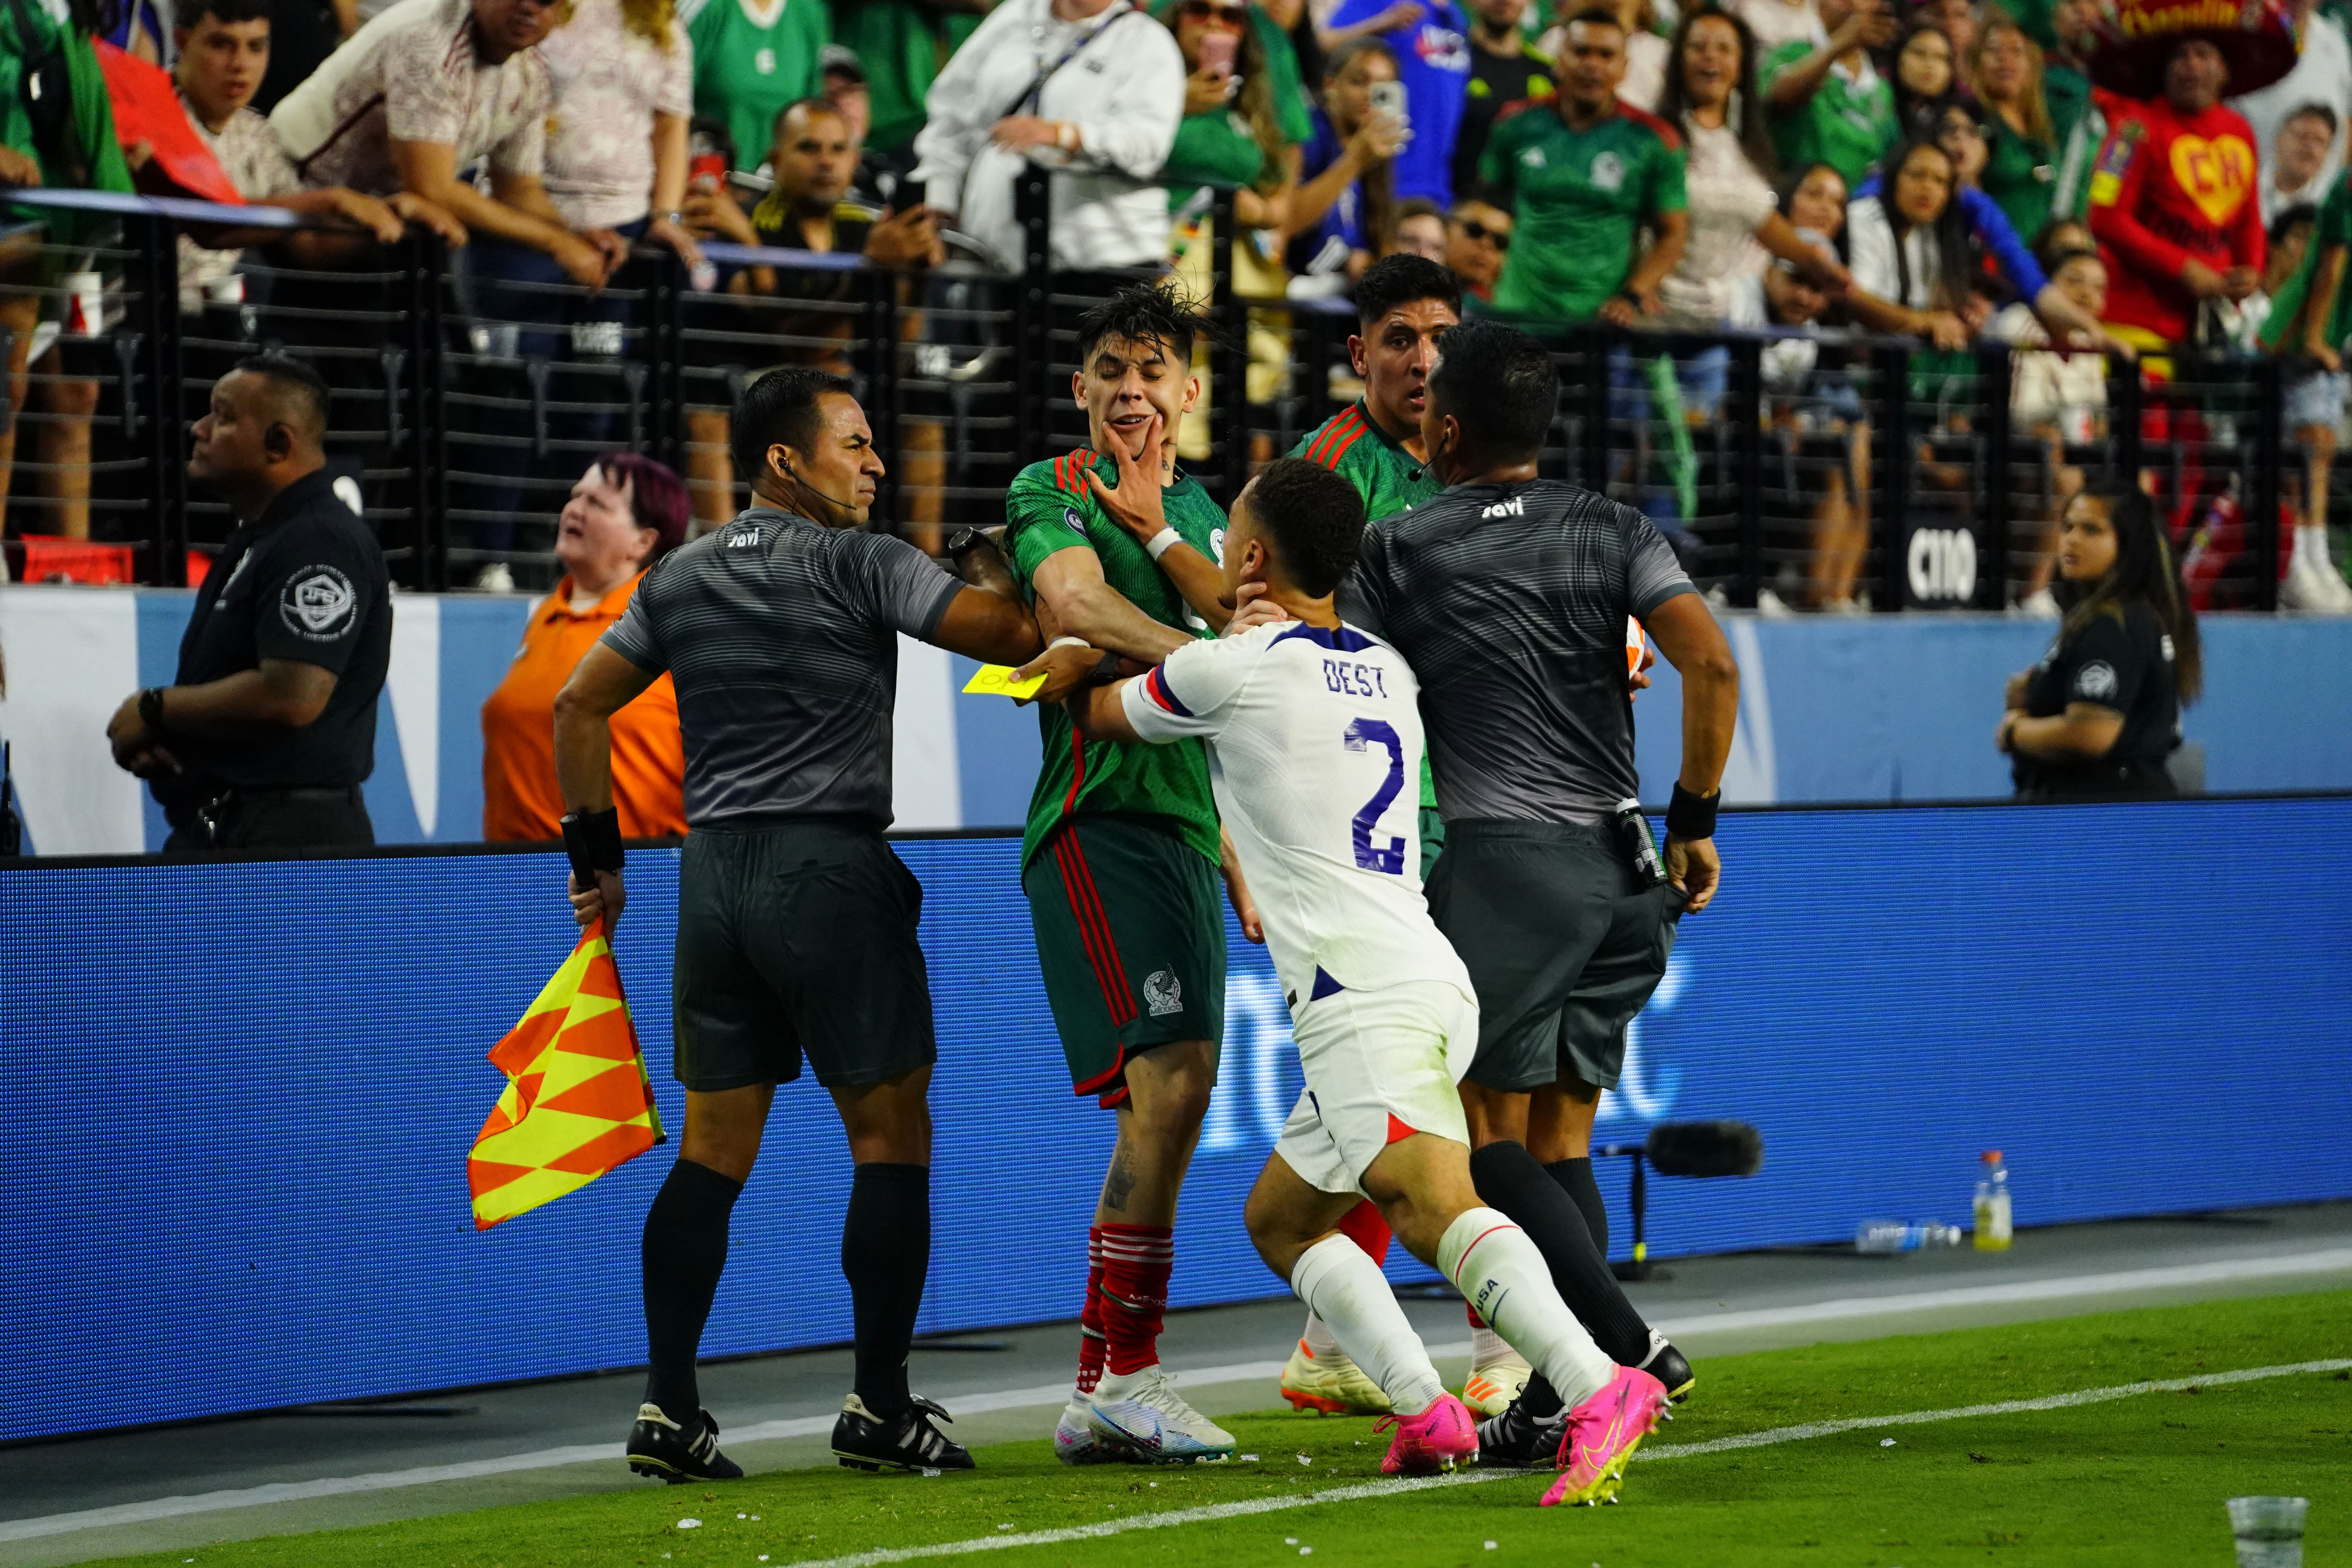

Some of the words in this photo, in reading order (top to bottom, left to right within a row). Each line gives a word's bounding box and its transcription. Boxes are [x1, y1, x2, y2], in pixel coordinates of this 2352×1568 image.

[1322, 658, 1387, 698] DEST
[1343, 717, 1406, 875] 2
[1150, 1004, 1182, 1014] MÉXICO
[1476, 1278, 1498, 1311] USA
